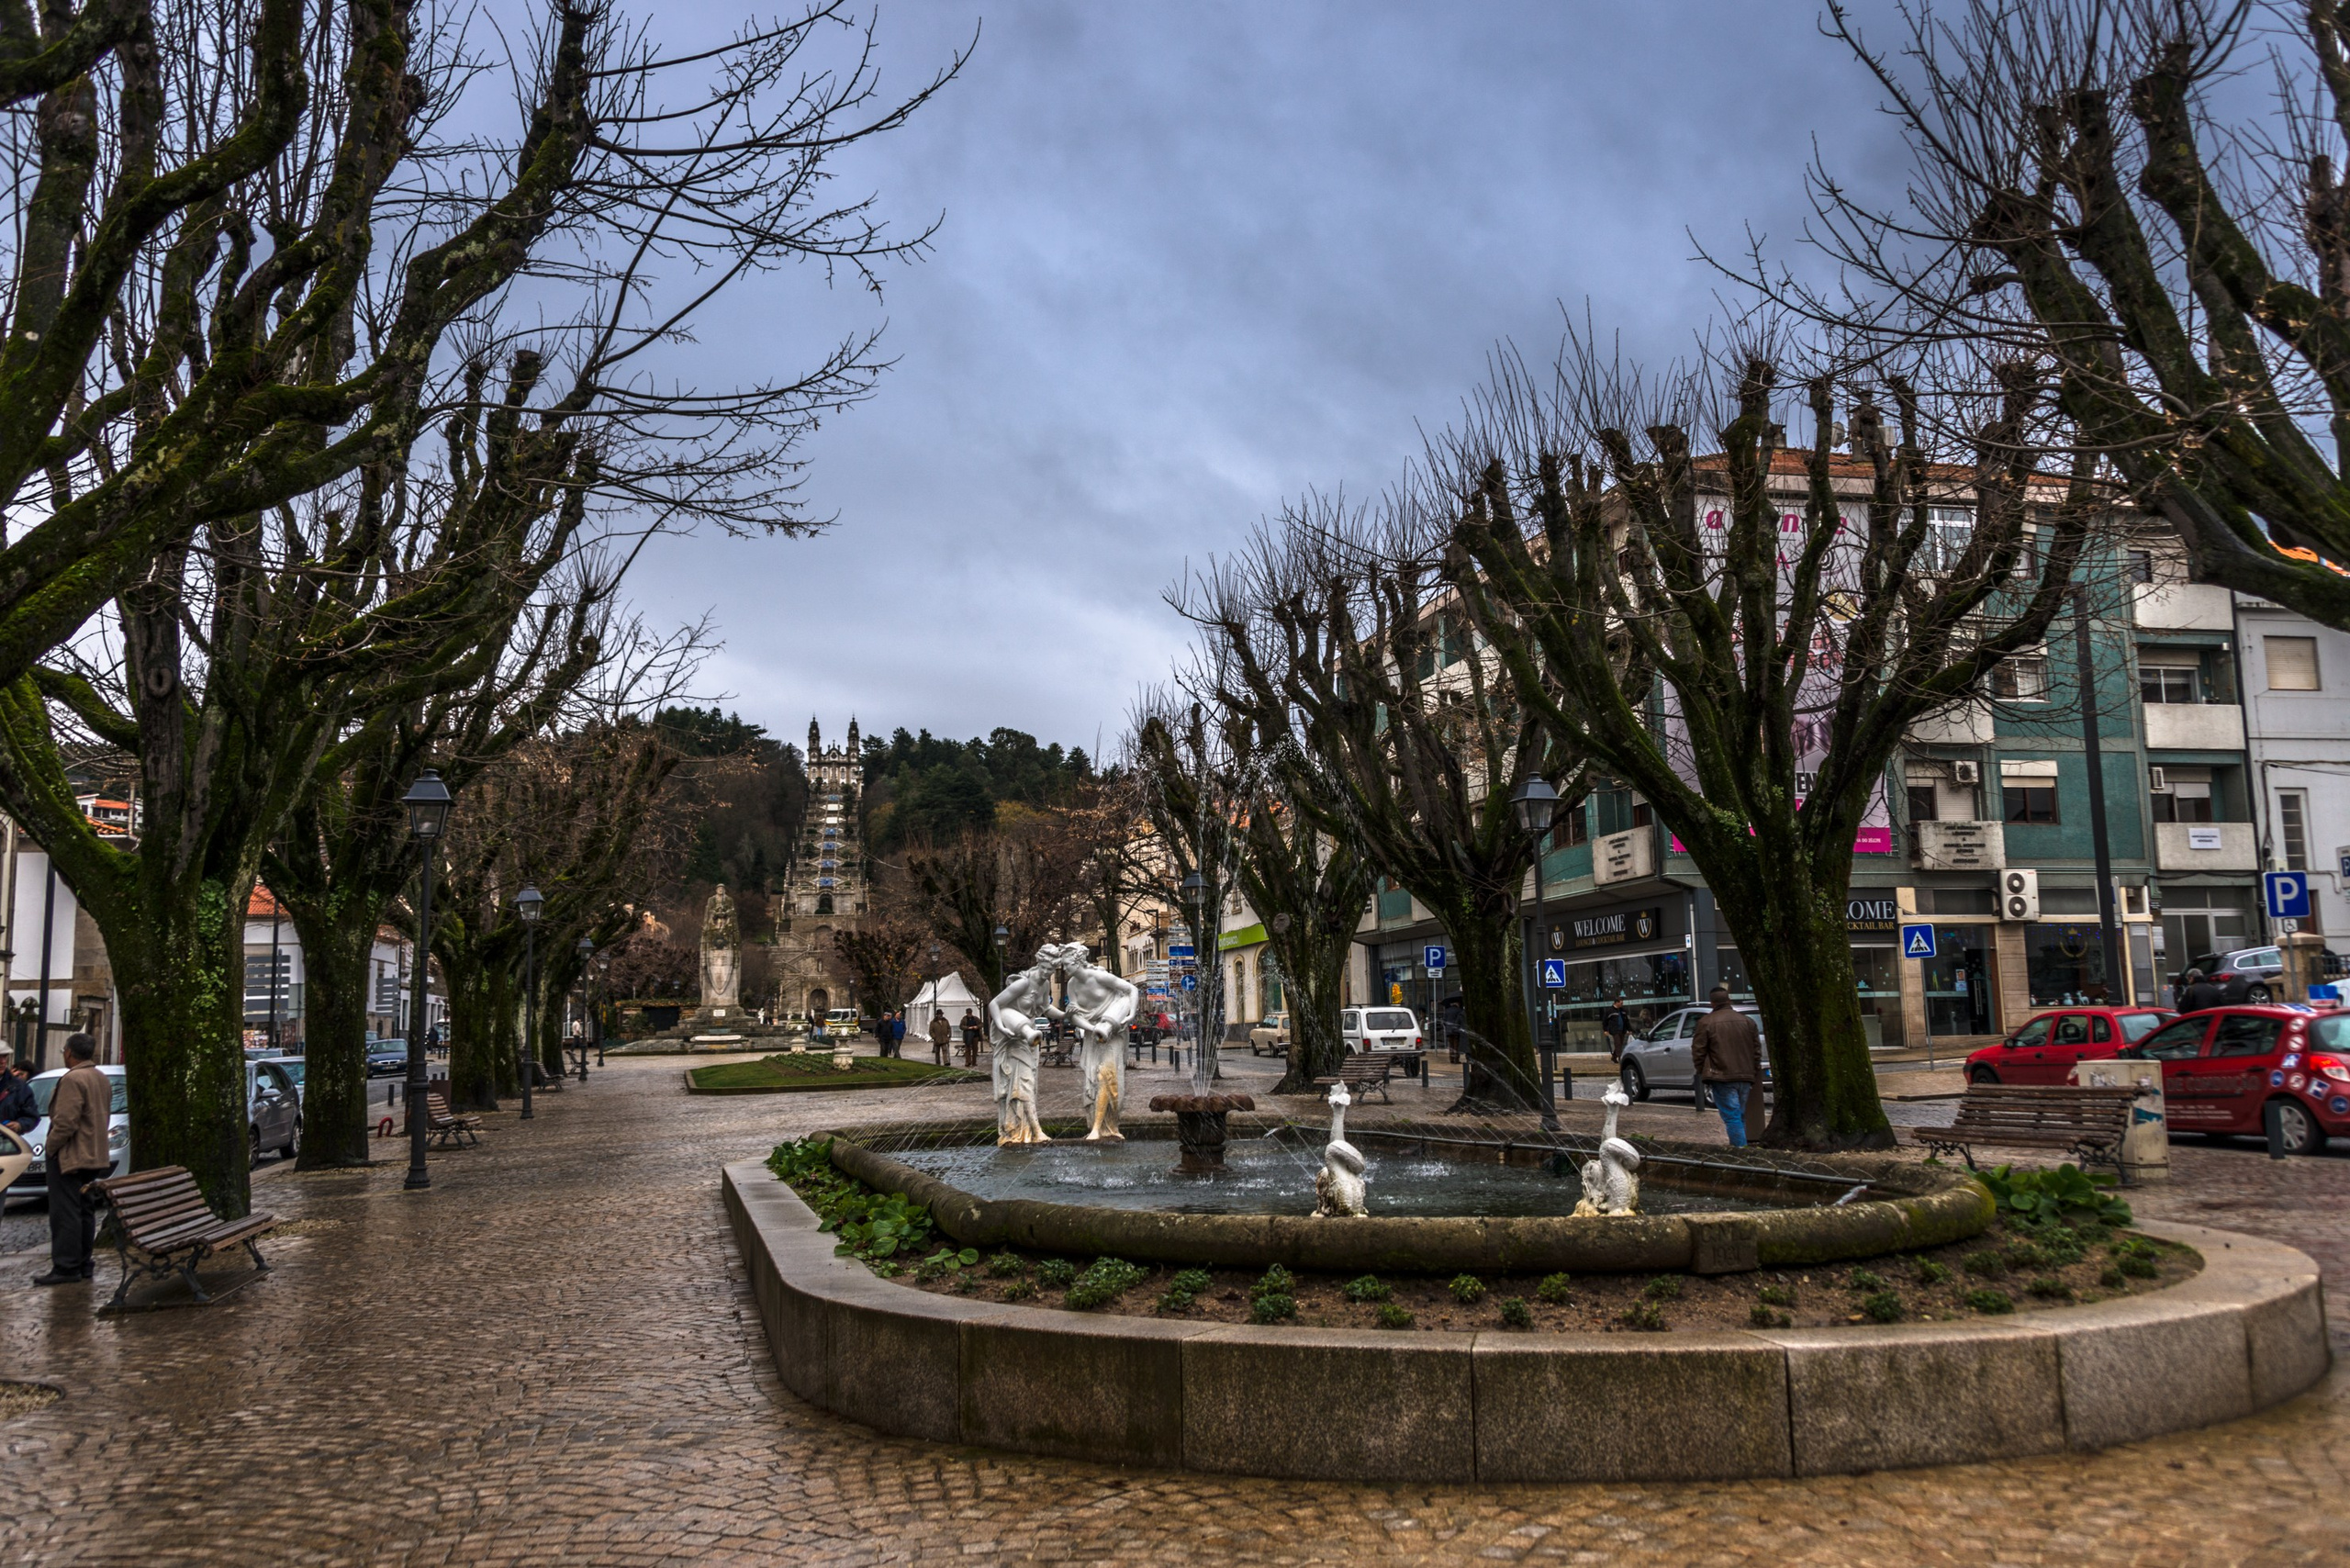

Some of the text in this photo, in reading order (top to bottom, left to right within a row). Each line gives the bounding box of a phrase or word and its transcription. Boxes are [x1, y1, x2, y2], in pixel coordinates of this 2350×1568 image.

[2274, 877, 2300, 913] P
[1573, 913, 1626, 937] WELCOME
[1878, 921, 1895, 930] BAR
[1429, 948, 1441, 966] P
